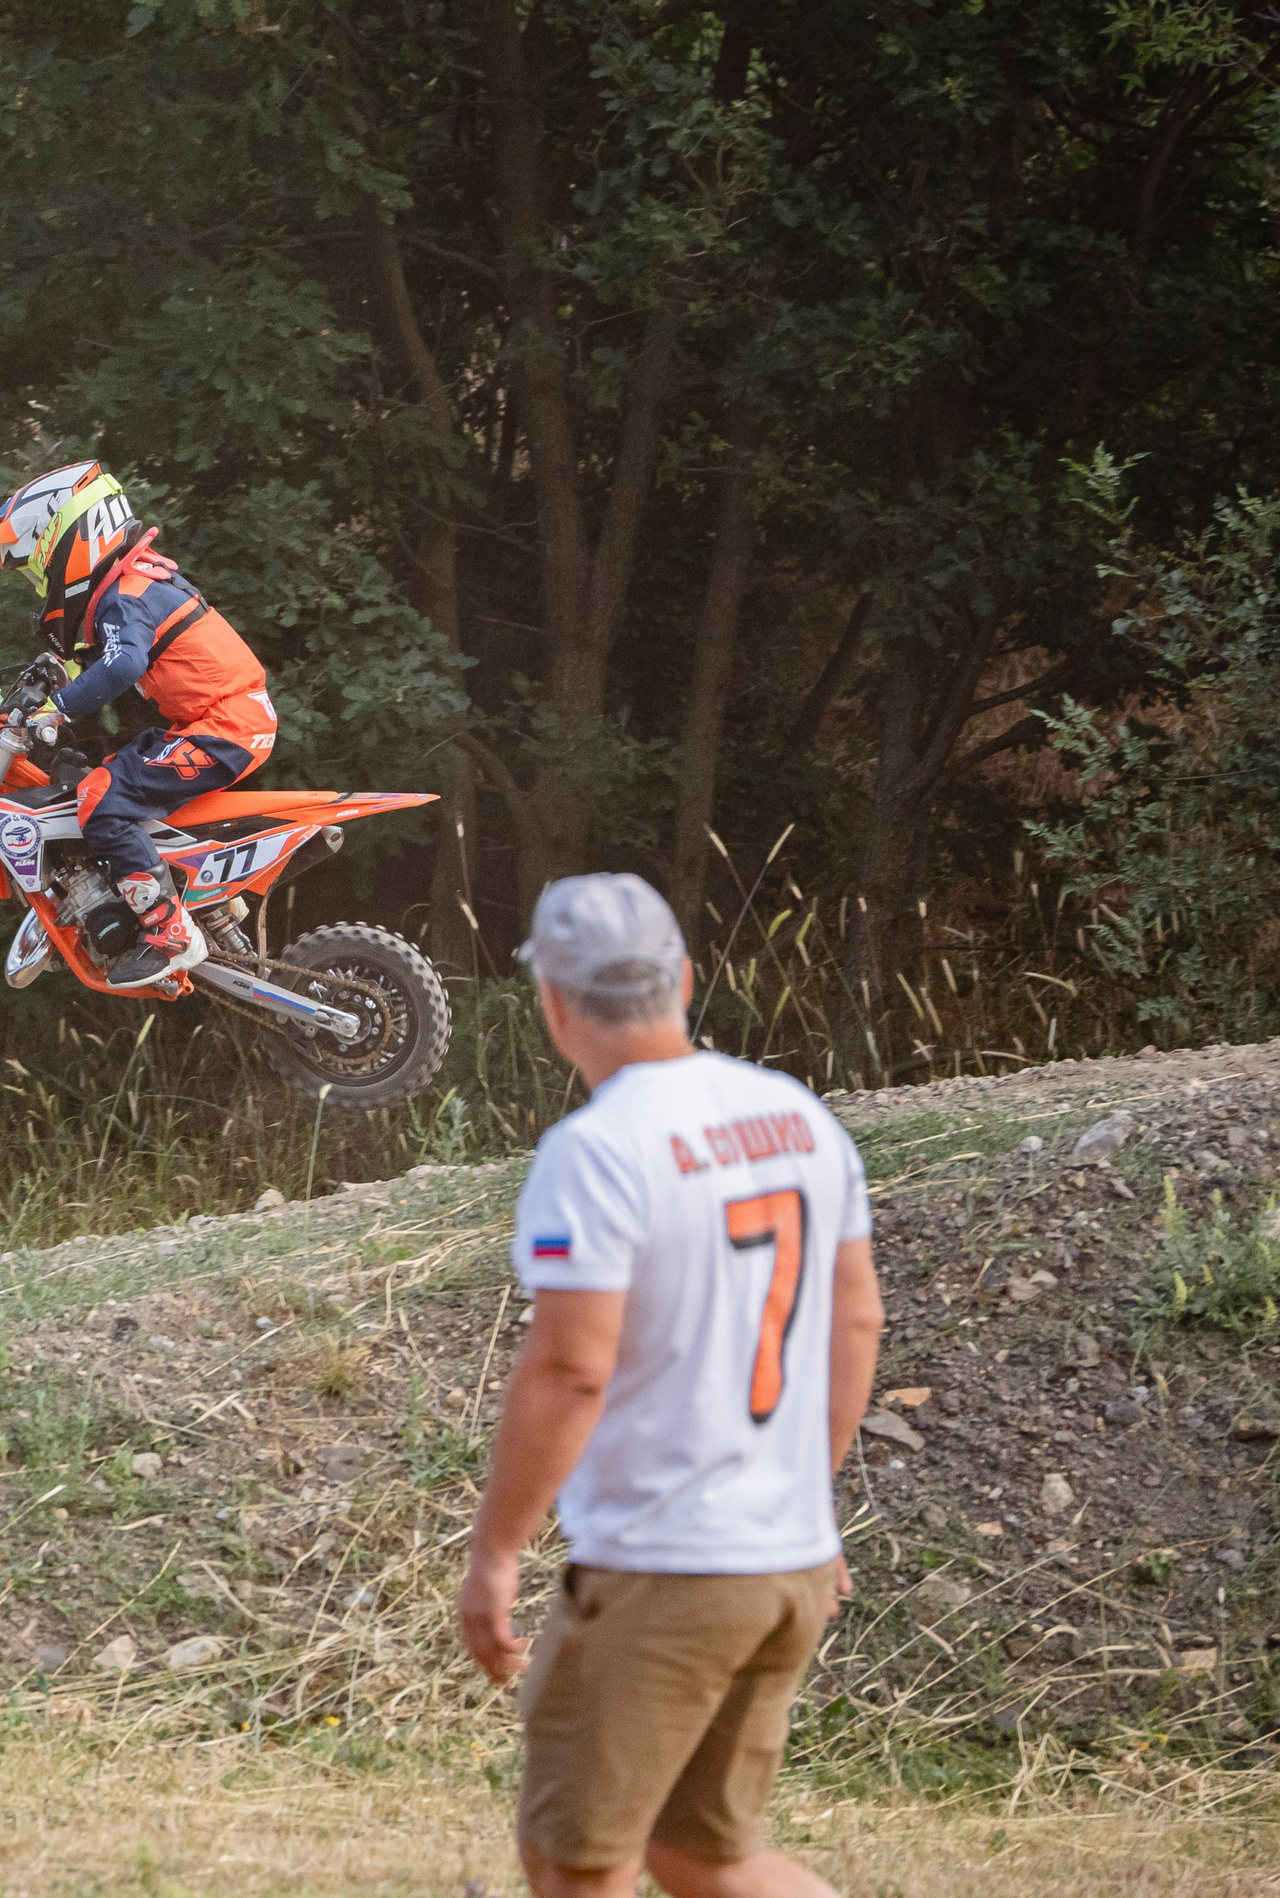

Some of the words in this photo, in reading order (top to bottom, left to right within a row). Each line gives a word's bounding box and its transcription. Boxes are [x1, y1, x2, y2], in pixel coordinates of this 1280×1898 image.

[48, 632, 65, 653] AIROH
[336, 809, 359, 817] KTM
[14, 859, 36, 867] KTM
[213, 841, 257, 883] 77
[725, 1187, 808, 1425] 7
